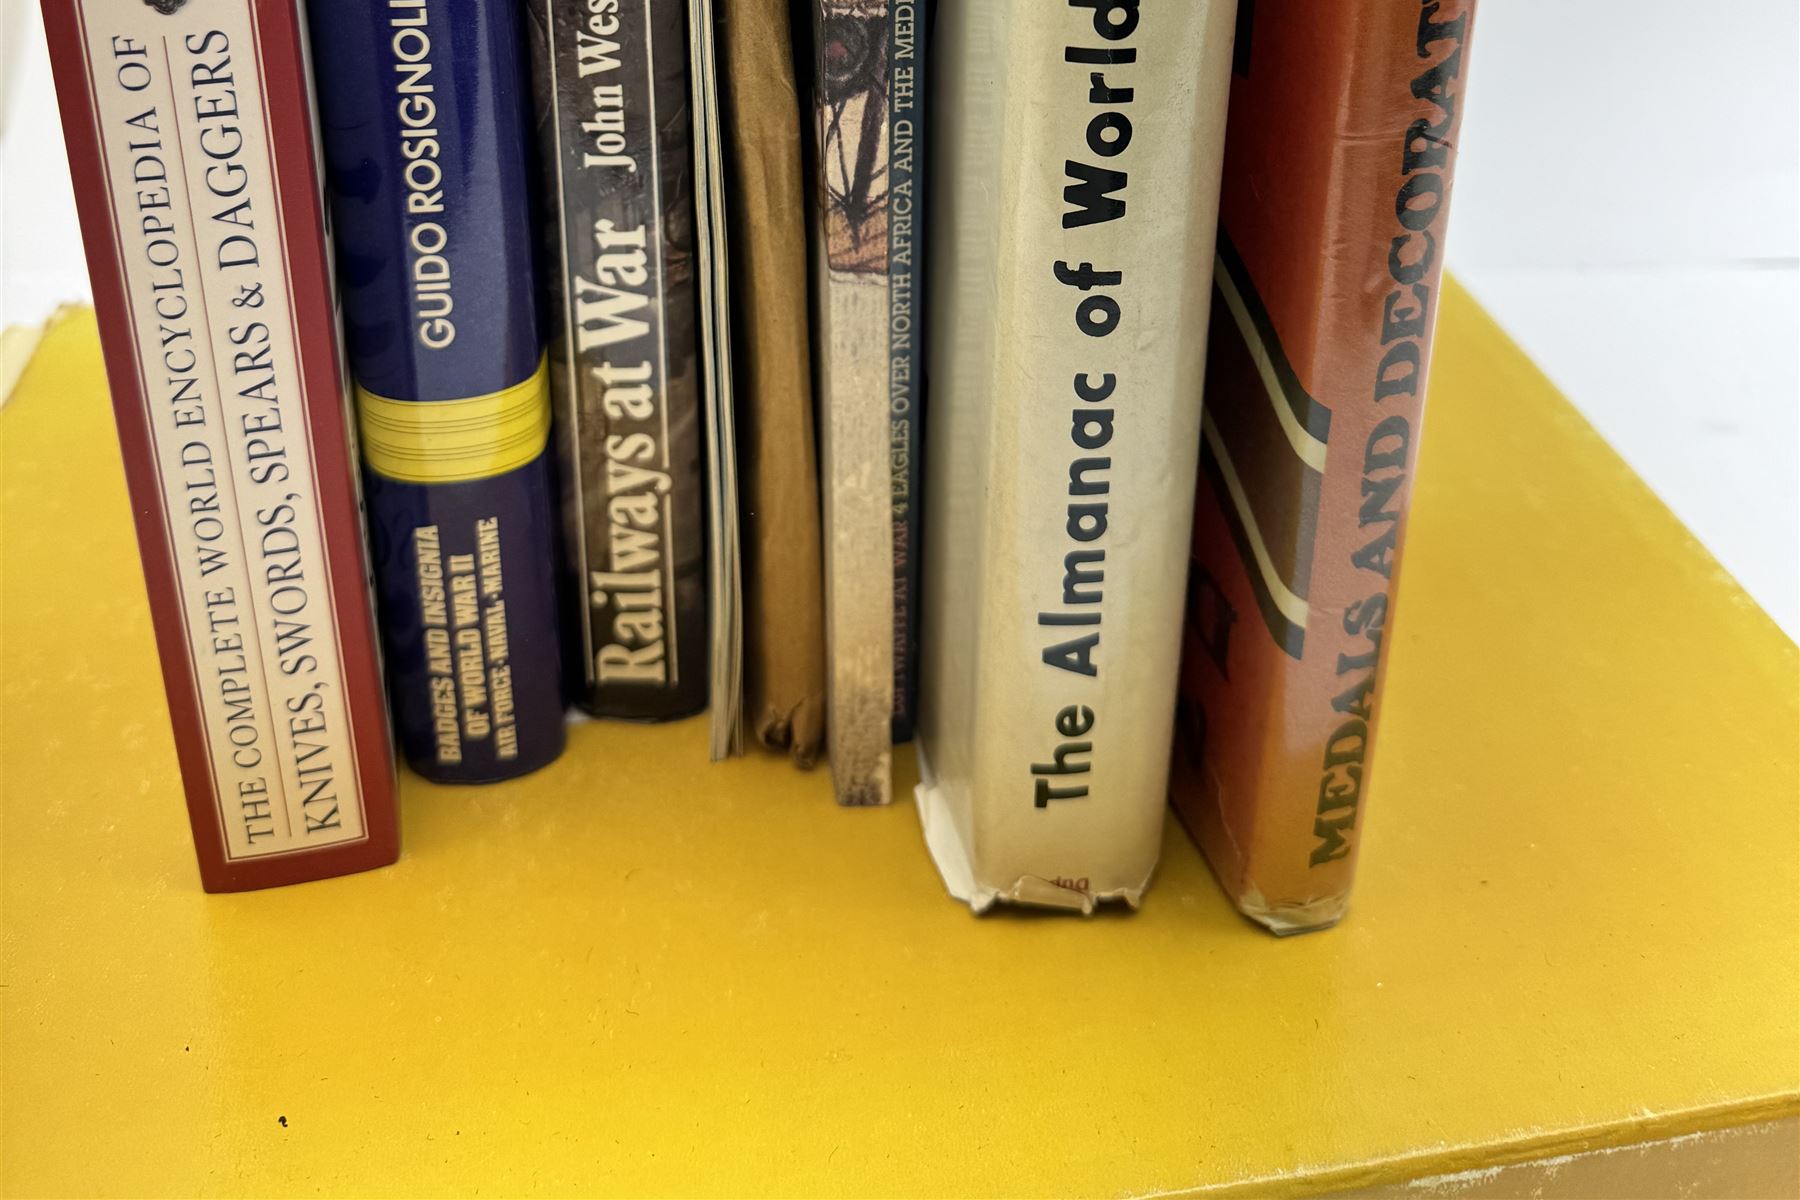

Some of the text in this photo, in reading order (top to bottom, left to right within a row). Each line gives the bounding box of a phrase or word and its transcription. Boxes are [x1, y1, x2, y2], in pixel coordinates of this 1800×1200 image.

[580, 84, 637, 173] John
[894, 66, 914, 111] THE
[388, 0, 456, 349] GUIDO ROSIGNOLI
[893, 119, 913, 173] AND
[892, 179, 913, 265] AFRICA
[892, 273, 911, 349] NORTH
[1053, 260, 1123, 338] of
[185, 29, 343, 835] KNIVES, SWORDS, SPEARS & DAGGERS
[891, 356, 911, 413] OVER
[112, 35, 275, 844] THE COMPLETE WORLD ENCYCLOPEDIA OF
[575, 219, 672, 681] Railways at War
[891, 420, 910, 497] EAGLES
[1037, 372, 1117, 678] Almanac
[415, 525, 462, 761] BADGES AND INSIGNIA
[448, 554, 490, 737] OF WORLD WAR II
[1308, 595, 1387, 872] MEDALS
[1351, 420, 1408, 578] AND
[496, 723, 519, 758] AIR
[1030, 704, 1094, 809] The
